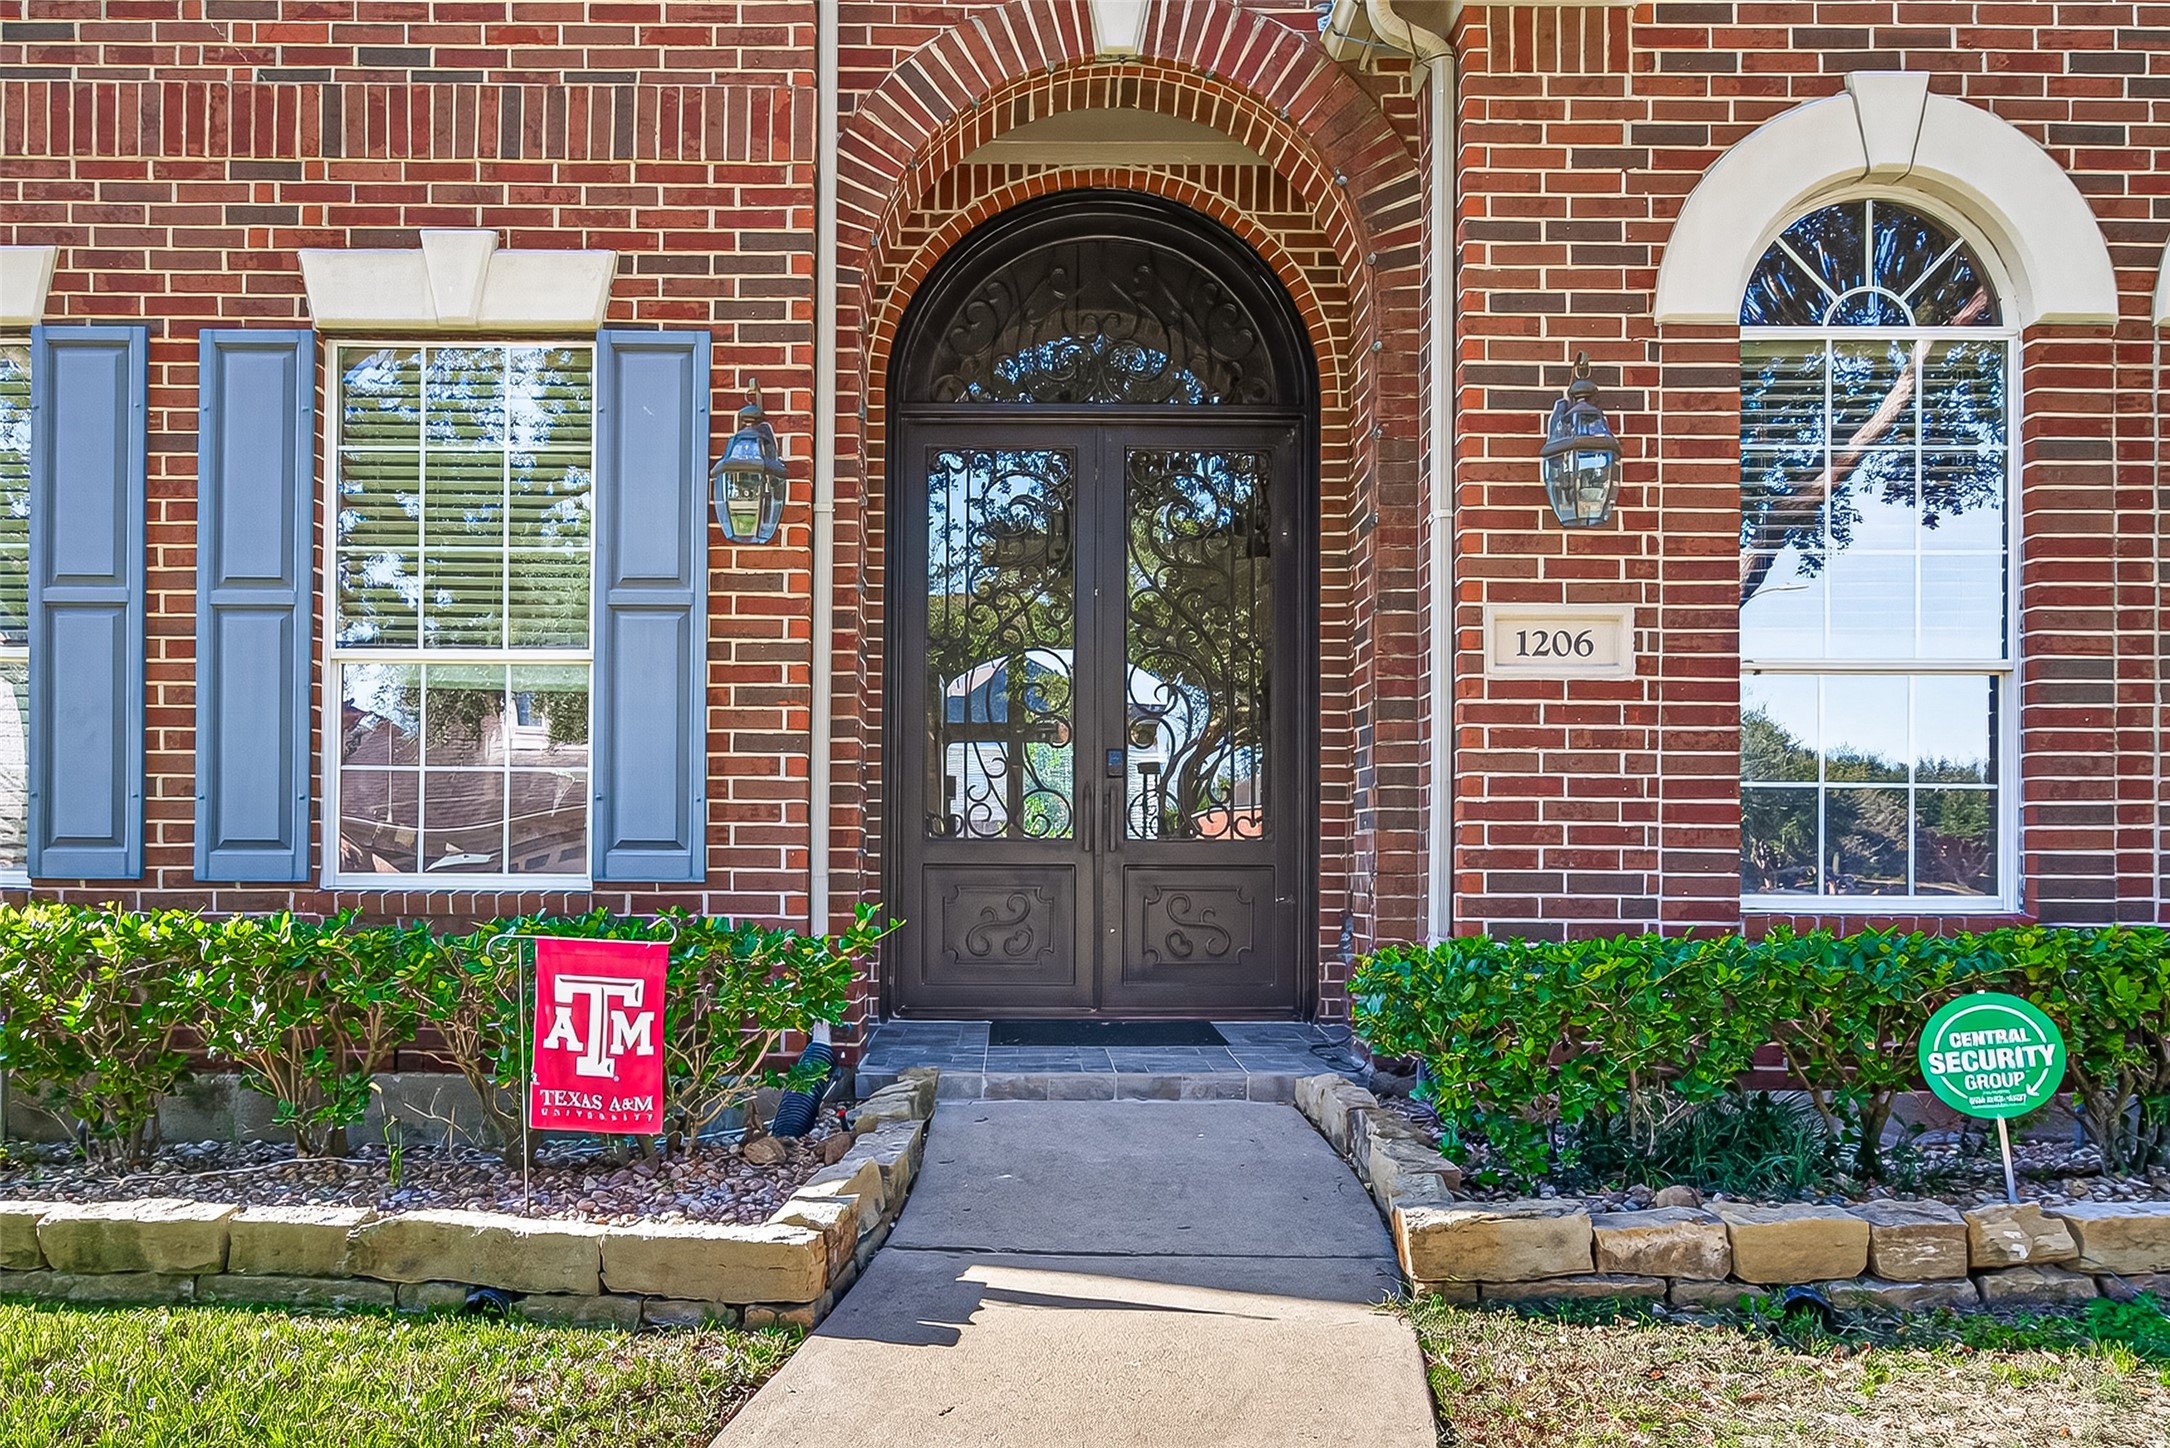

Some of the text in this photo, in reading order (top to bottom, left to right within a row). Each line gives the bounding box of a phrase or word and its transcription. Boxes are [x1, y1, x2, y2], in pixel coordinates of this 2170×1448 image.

[1516, 629, 1595, 658] 1206
[1948, 1027, 2031, 1049] CENTRAL
[1928, 1043, 2056, 1075] SECURITY
[1964, 1071, 2026, 1091] GROUP
[540, 1089, 654, 1112] TEXAS A&M
